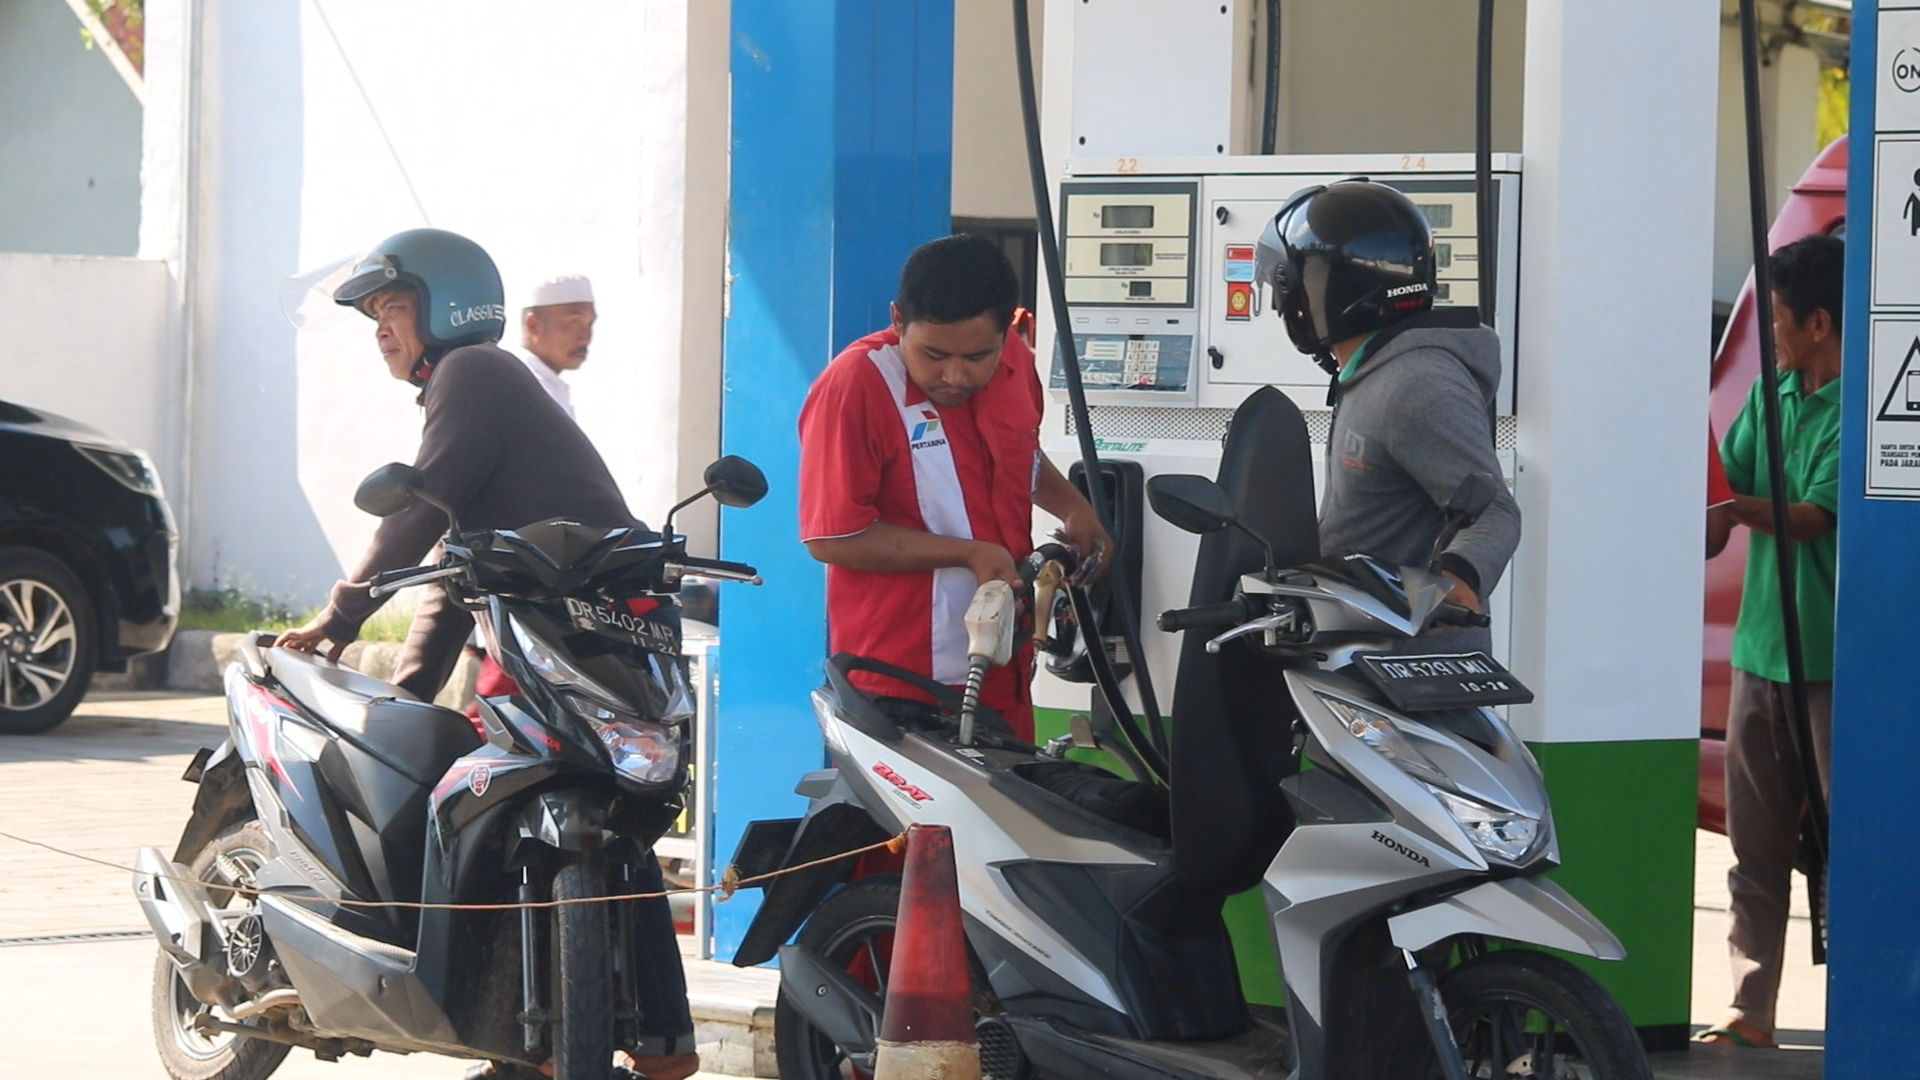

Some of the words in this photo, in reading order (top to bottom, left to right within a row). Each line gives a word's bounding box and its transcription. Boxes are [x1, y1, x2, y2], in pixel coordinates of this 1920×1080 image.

[1387, 283, 1428, 298] HONDA
[565, 597, 596, 620] DR
[595, 606, 648, 636] 5402
[1371, 829, 1431, 869] HONDA
